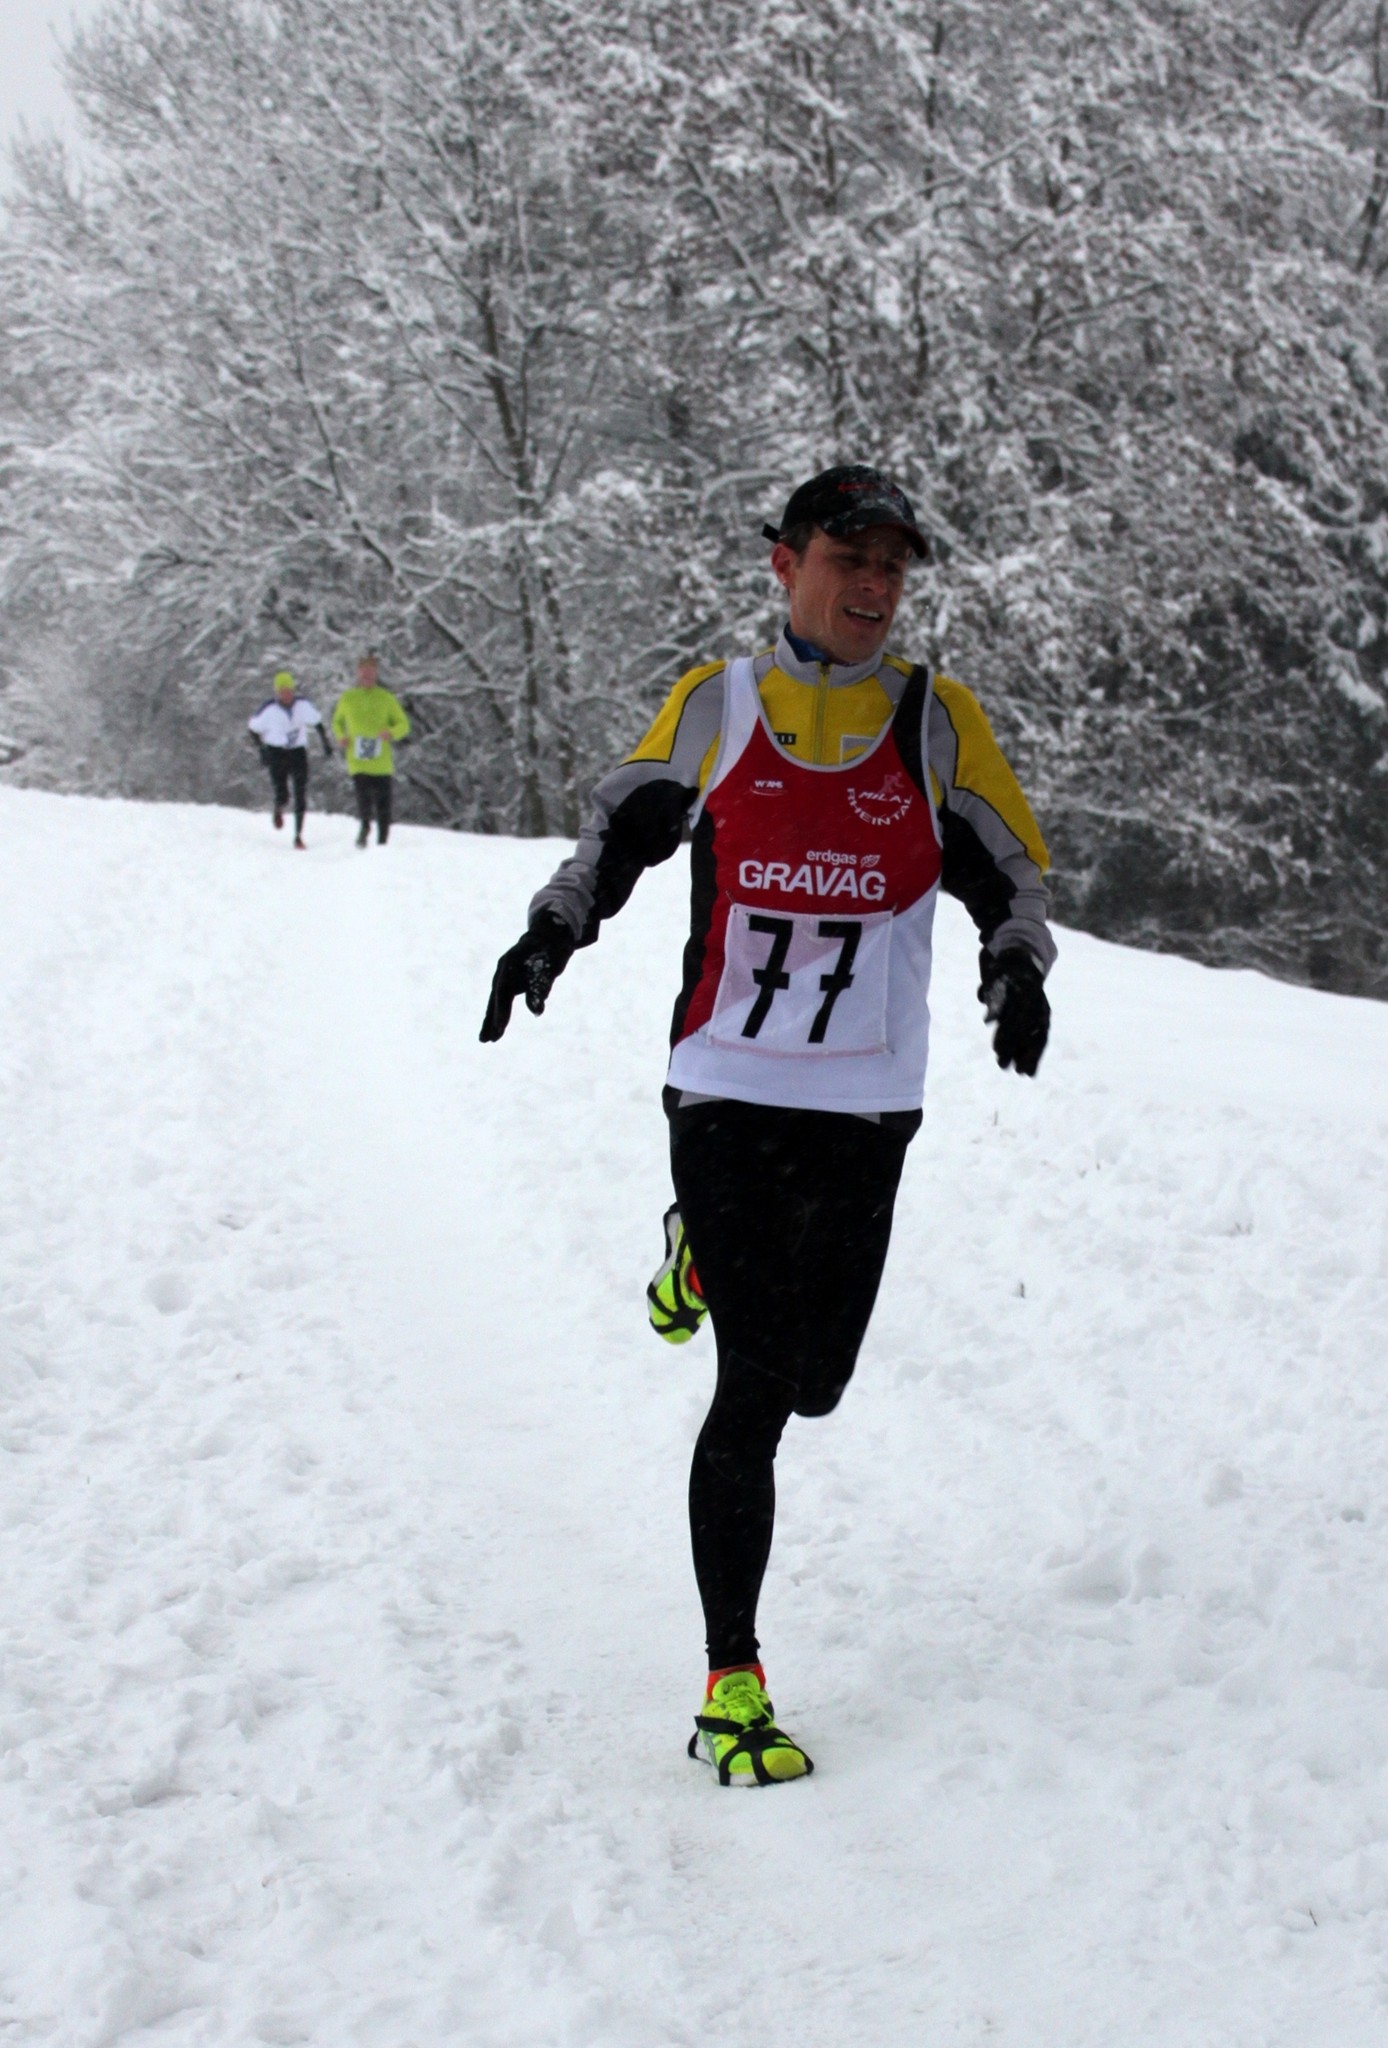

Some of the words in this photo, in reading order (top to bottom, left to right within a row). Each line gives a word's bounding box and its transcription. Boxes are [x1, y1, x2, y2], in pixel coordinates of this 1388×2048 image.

[806, 849, 857, 865] erdgas
[739, 860, 887, 901] GRAVAG
[741, 914, 862, 1043] 77
